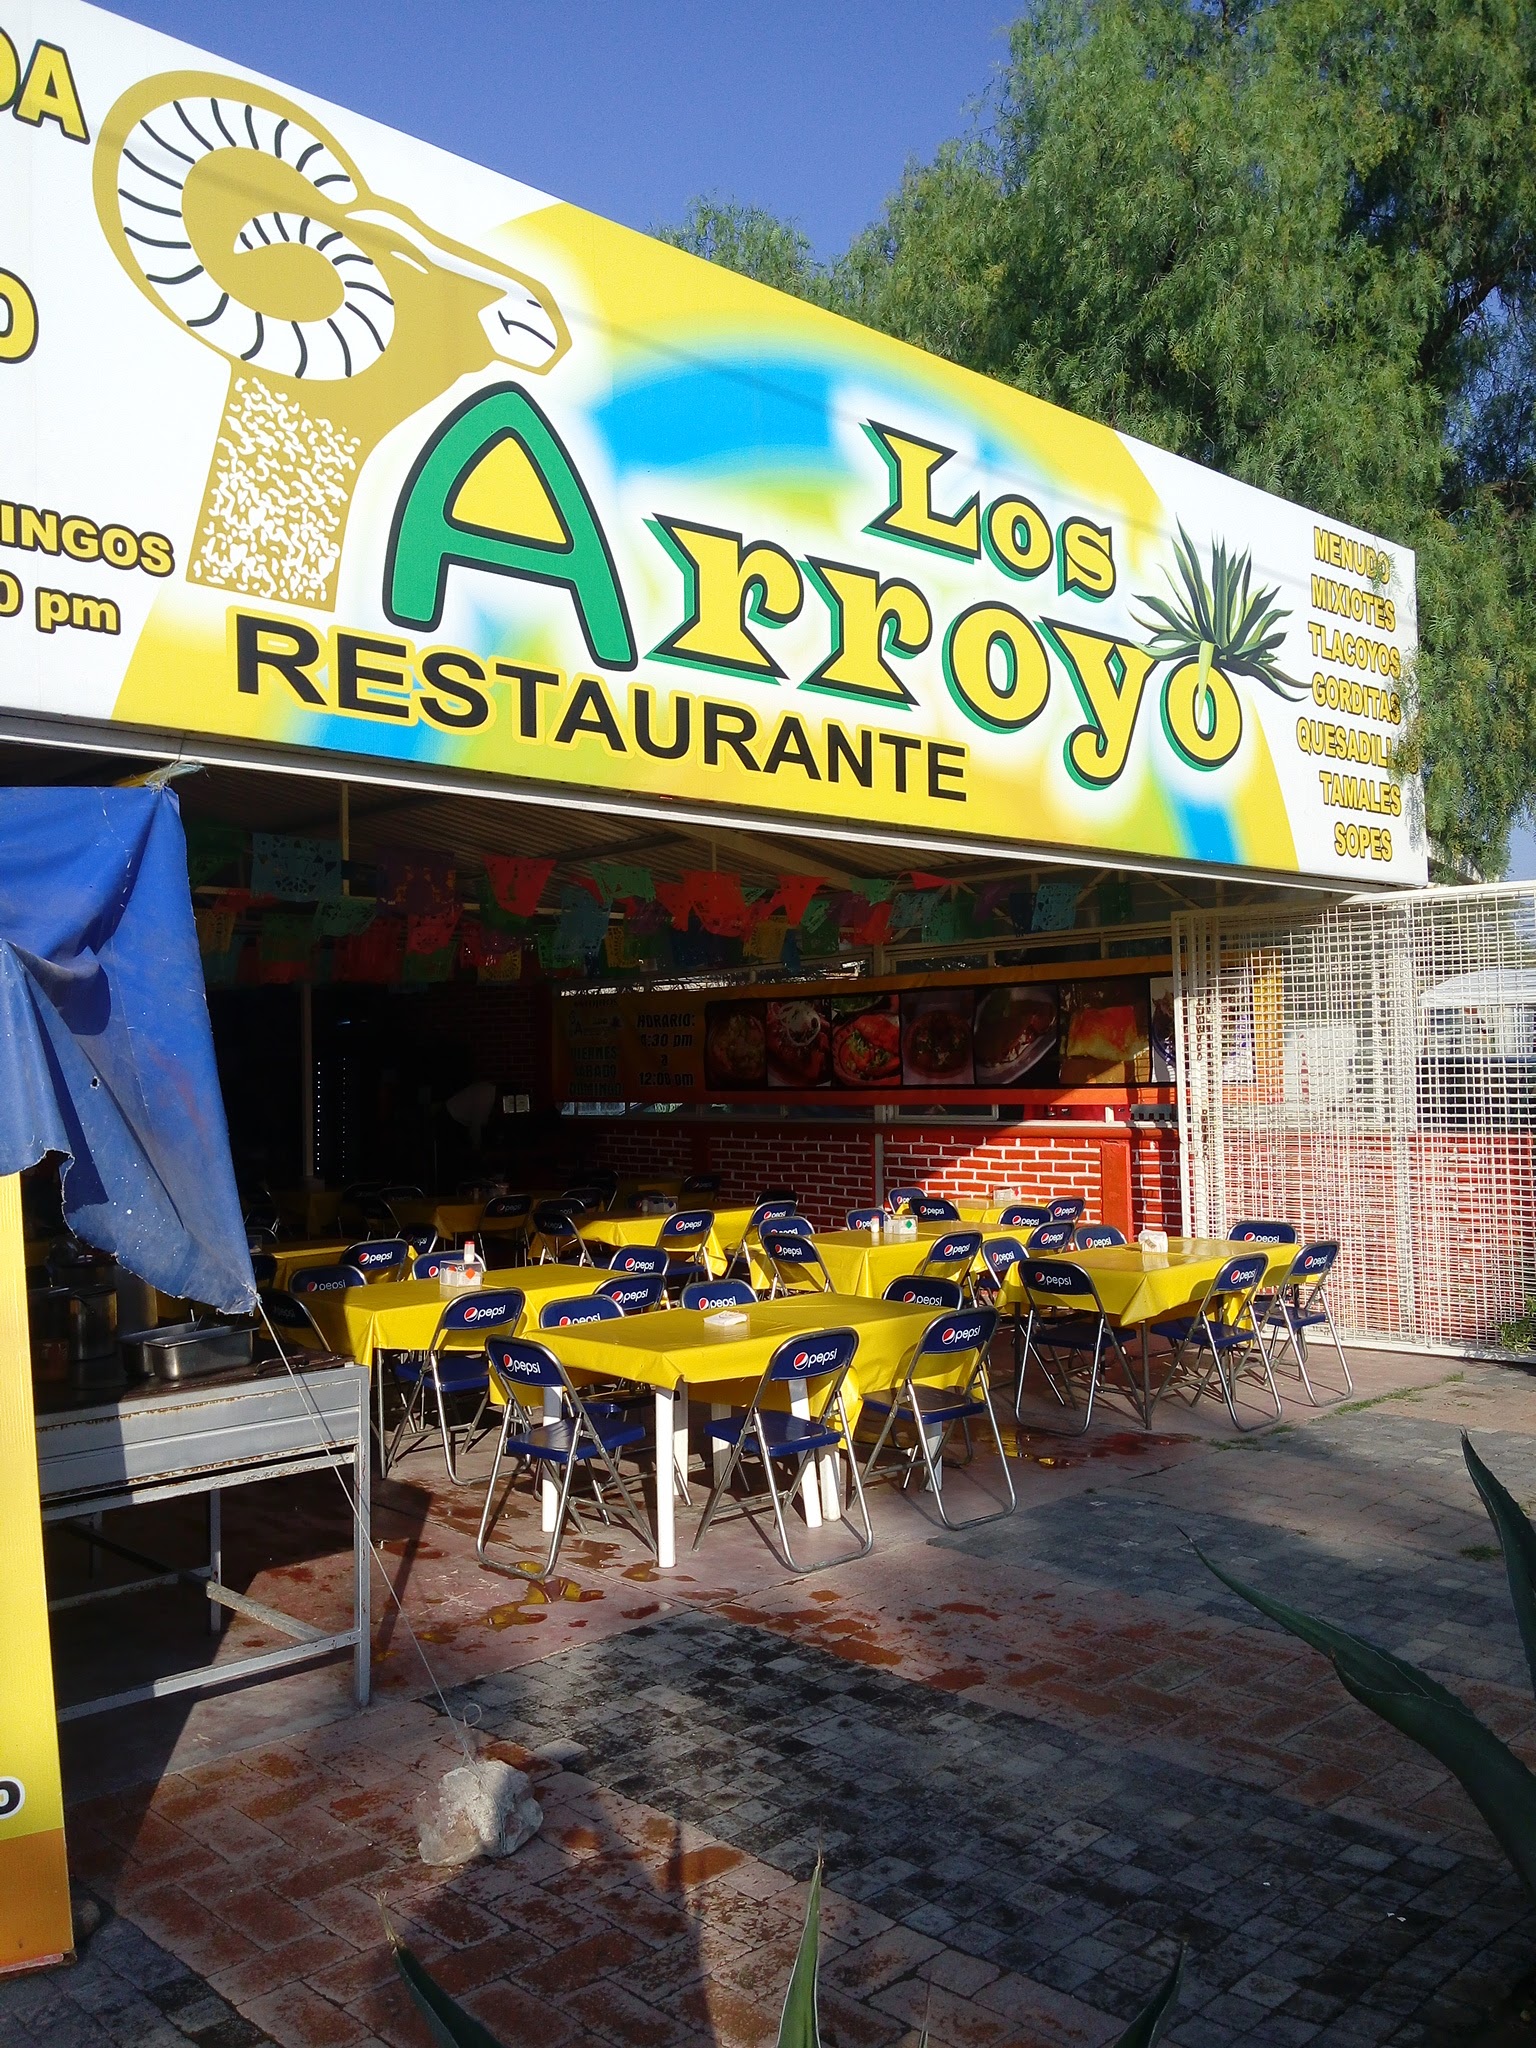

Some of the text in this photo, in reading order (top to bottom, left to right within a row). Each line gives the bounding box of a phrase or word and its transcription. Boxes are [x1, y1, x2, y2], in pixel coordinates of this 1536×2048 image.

[858, 418, 1116, 603] Los
[1313, 526, 1391, 585] MENUDO
[382, 380, 1242, 791] Arroyo
[1311, 573, 1396, 633] MIXIOTES
[35, 586, 121, 635] pm
[1307, 621, 1401, 679] TLACOYOS
[1311, 671, 1401, 725] GORDITAS
[233, 611, 968, 803] RESTAURANTE
[1319, 770, 1402, 818] TAMALES
[1334, 822, 1393, 862] SOPES
[637, 1013, 695, 1028] HORARIO:
[673, 1034, 692, 1048] pm
[661, 1054, 668, 1066] a
[926, 1207, 945, 1216] pepsi
[1060, 1206, 1076, 1217] pepsi
[684, 1220, 702, 1230] pepsi
[1020, 1217, 1040, 1227] pepsi
[1048, 1232, 1065, 1244] pepsi
[1093, 1236, 1112, 1248] pepsi
[1256, 1235, 1280, 1244] pepsi
[782, 1246, 802, 1257] pepsi
[952, 1243, 971, 1256] pepsi
[998, 1250, 1015, 1263] pepsi
[369, 1252, 393, 1263] pepsi
[1312, 1255, 1328, 1268] pepsi
[634, 1261, 655, 1272] pepsi
[1045, 1274, 1072, 1287] pepsi
[1238, 1268, 1256, 1283] pepsi
[623, 1288, 649, 1303] pepsi
[709, 1295, 737, 1309] pepsi
[916, 1295, 943, 1306] pepsi
[477, 1305, 506, 1321] pepsi
[954, 1325, 981, 1342] pepsi
[807, 1348, 838, 1368] pepsi
[513, 1359, 541, 1376] pepsi
